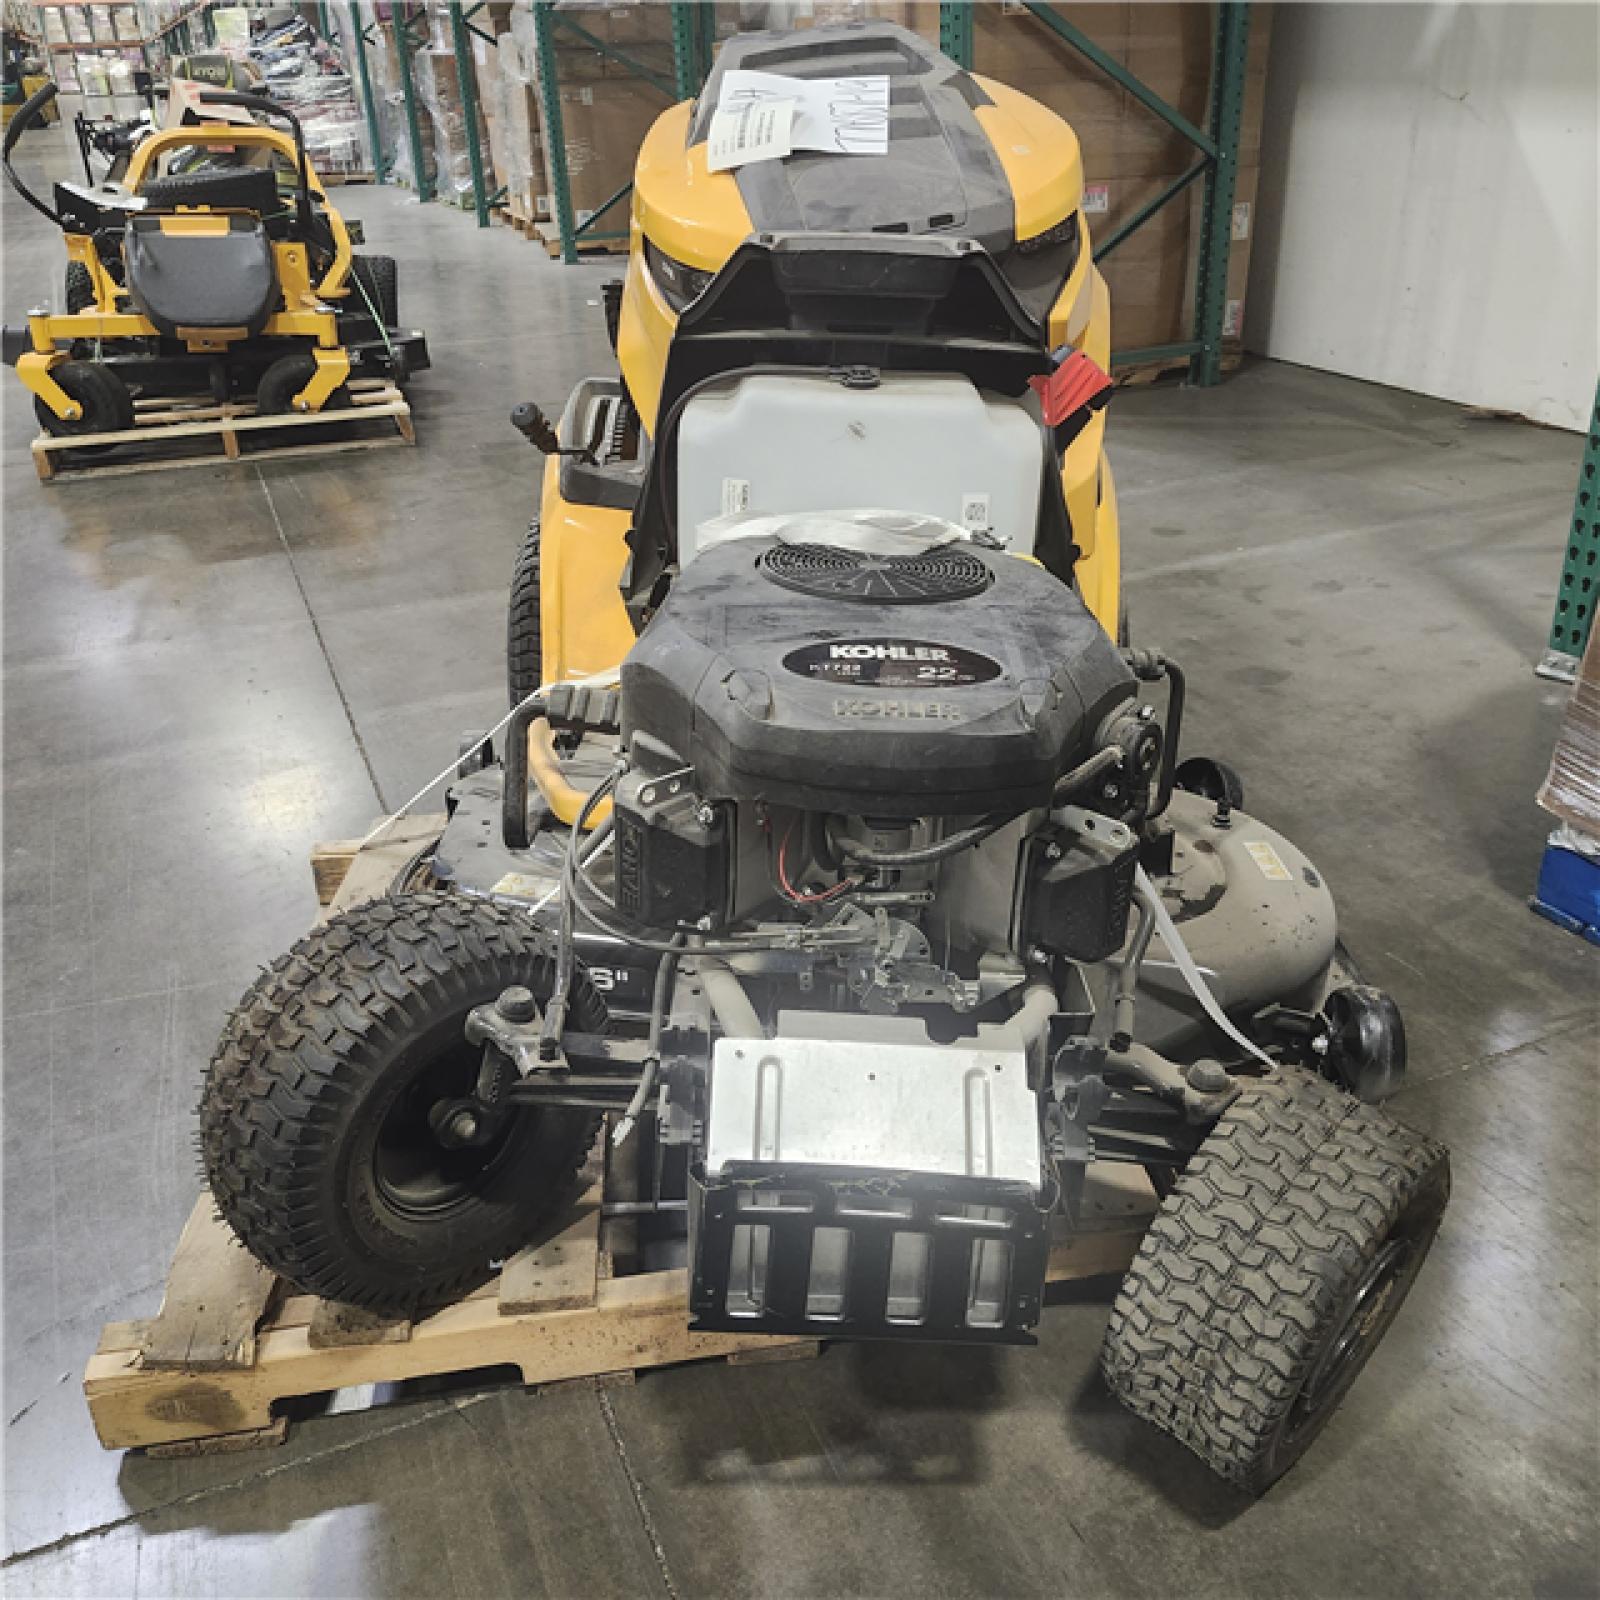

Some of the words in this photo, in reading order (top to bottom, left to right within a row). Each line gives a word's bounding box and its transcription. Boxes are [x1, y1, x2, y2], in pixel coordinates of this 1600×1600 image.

[829, 645, 949, 661] KOHLER
[917, 667, 957, 681] 22
[834, 700, 961, 720] KOHLER
